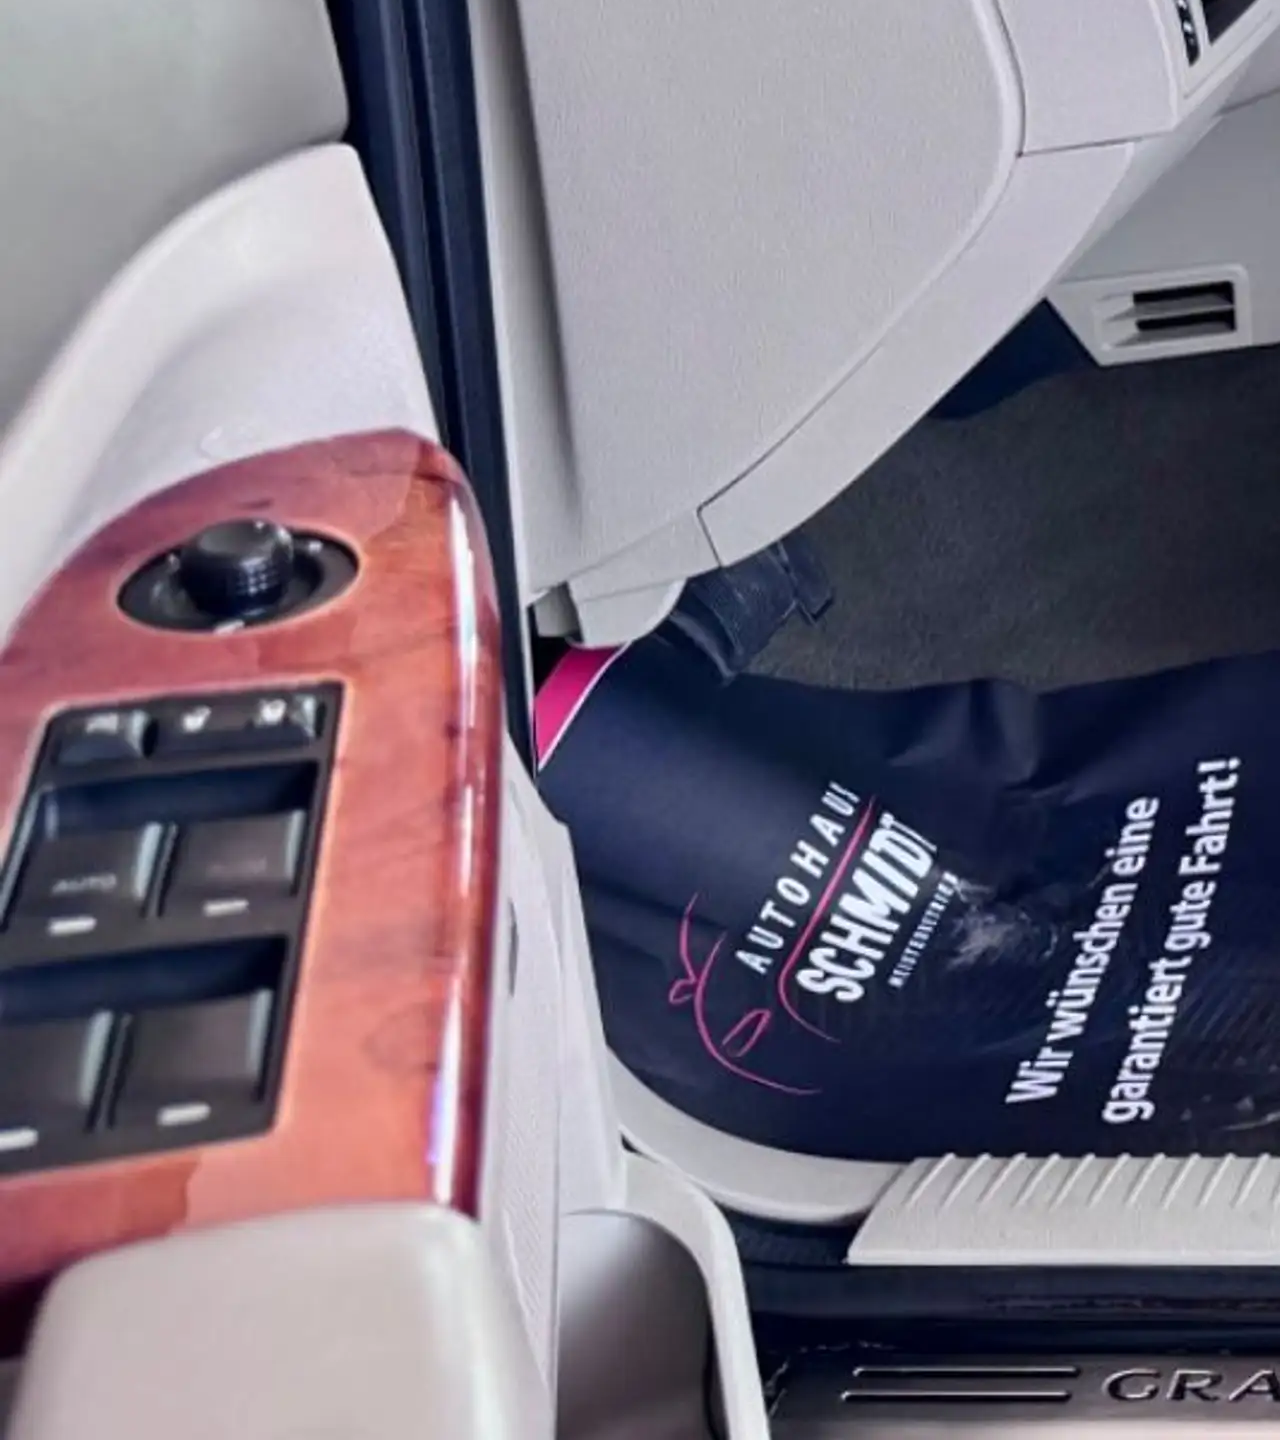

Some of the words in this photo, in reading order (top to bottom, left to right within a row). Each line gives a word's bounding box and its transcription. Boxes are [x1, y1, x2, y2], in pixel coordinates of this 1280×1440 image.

[1178, 756, 1241, 875] Fahrt!
[796, 811, 938, 1003] SCHMIDT
[1004, 1047, 1074, 1104] Wir
[1045, 882, 1139, 1043] wünschen
[1105, 796, 1160, 876] eine
[1163, 880, 1218, 951] gute
[1101, 955, 1193, 1123] garantiert
